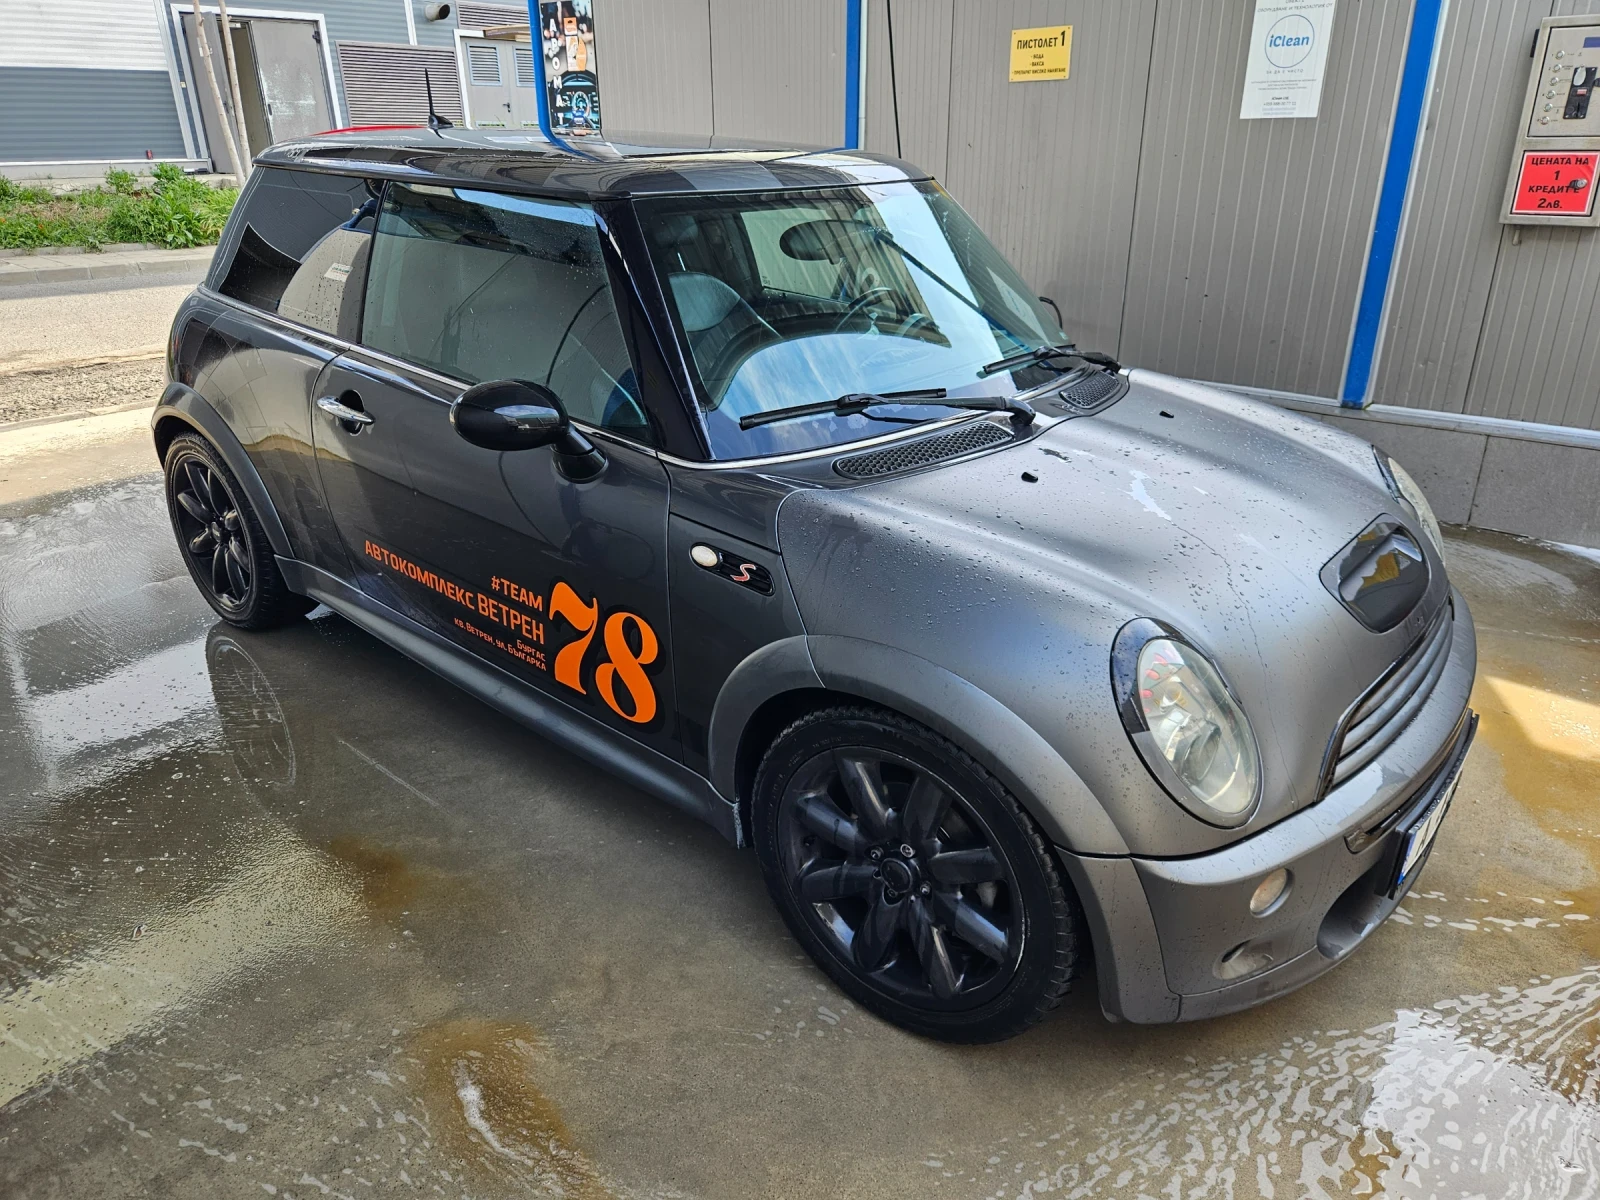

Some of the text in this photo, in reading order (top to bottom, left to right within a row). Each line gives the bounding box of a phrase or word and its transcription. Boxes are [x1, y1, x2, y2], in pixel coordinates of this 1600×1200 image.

[1016, 30, 1066, 50] ПИСТОЛЕТ 1
[1269, 34, 1310, 48] iClean
[1531, 157, 1589, 166] ЦЕНАТА НА
[1554, 170, 1560, 181] 1
[1528, 185, 1570, 194] КРЕДИТ
[1537, 197, 1563, 209] 2лв.
[365, 539, 475, 610] АВТОКОМПЛЕКС
[730, 563, 757, 582] S
[490, 575, 543, 612] #TEAM
[477, 592, 545, 645] ВЕТРЕН
[516, 639, 546, 662] БУРГАС
[549, 581, 659, 724] 78
